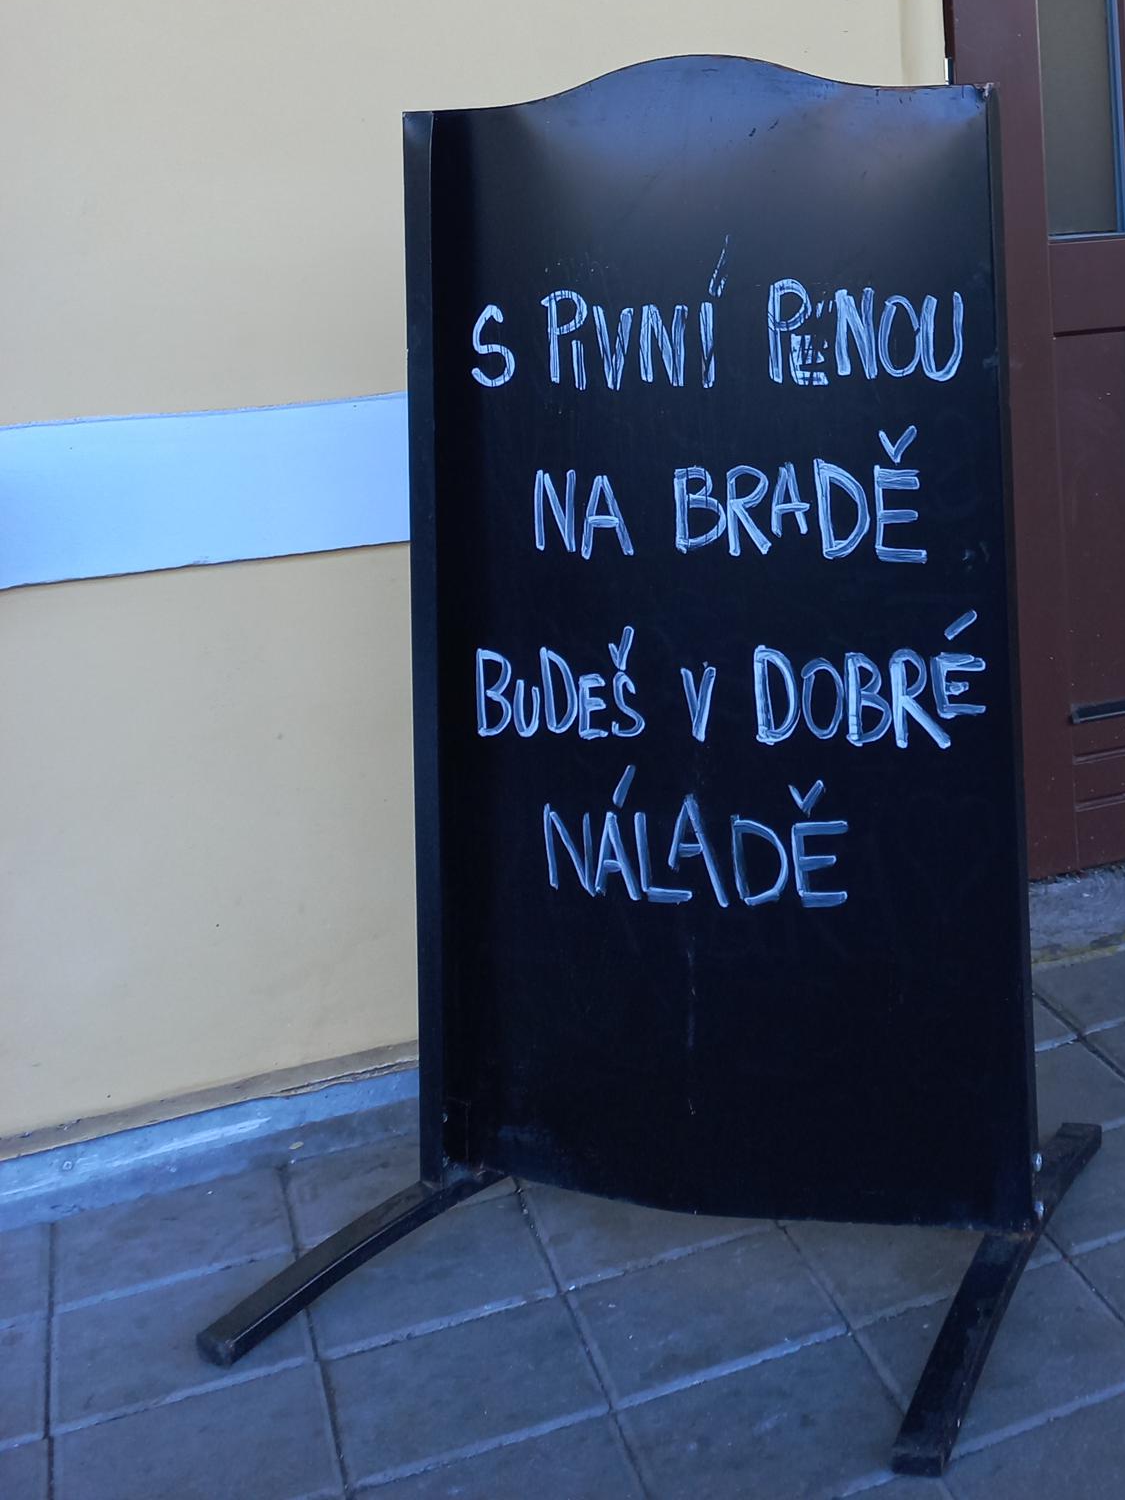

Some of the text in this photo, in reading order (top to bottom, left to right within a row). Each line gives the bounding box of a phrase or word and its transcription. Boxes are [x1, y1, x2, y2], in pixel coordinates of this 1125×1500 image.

[471, 304, 516, 387] S
[533, 424, 928, 563] NA BRADĚ
[681, 666, 717, 742] V
[753, 609, 987, 749] DOBRÉ
[544, 764, 849, 908] NÁLADĚ
